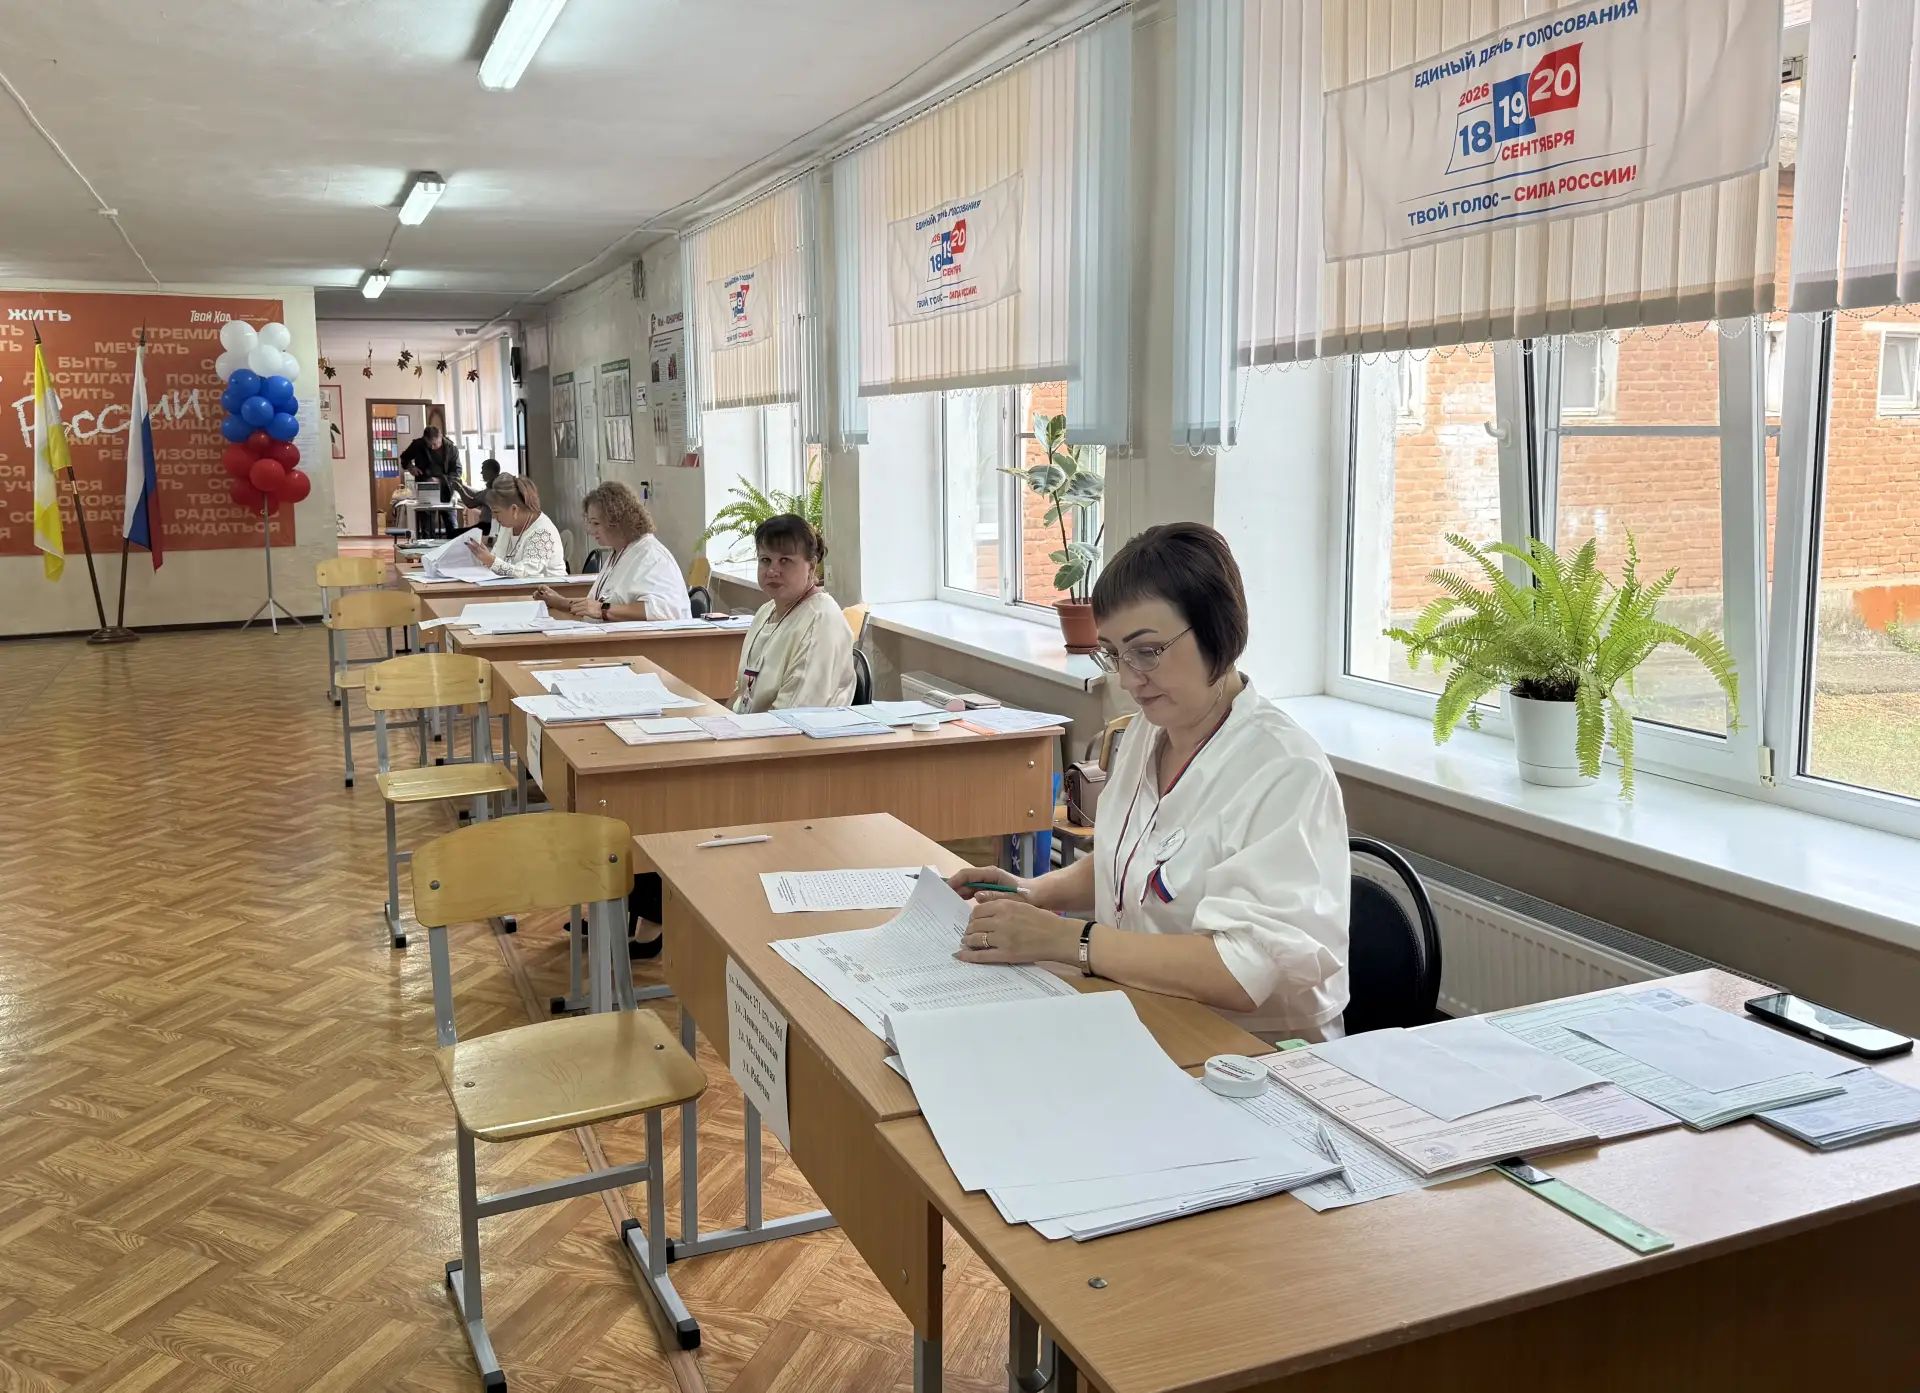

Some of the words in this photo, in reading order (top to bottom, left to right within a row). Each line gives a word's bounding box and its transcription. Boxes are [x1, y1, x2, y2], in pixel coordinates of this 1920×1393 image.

[1414, 51, 1476, 88] ЕДИНЫЙ
[1479, 38, 1514, 67] ДЕНЬ
[1517, 0, 1639, 49] ГОЛОСОВАНИЯ
[1458, 83, 1490, 107] 2026
[1459, 120, 1493, 157] 18
[1499, 91, 1527, 129] 19
[1531, 62, 1577, 102] 20
[1501, 129, 1575, 161] СЕНТЯБРЯ
[1408, 201, 1449, 226] ТВОЙ
[1453, 192, 1499, 216] ГОЛОС
[1514, 181, 1556, 202] СИЛА
[1558, 165, 1637, 193] РОССИИ!
[930, 254, 942, 273] 18
[951, 228, 966, 247] 20
[8, 309, 72, 321] ЖИТЬ
[132, 327, 222, 340] СТРЕМИ
[58, 356, 118, 369] БЫТЬ
[23, 371, 147, 386] ДСТИГАТ
[4, 480, 103, 492] УЧЬСЯ
